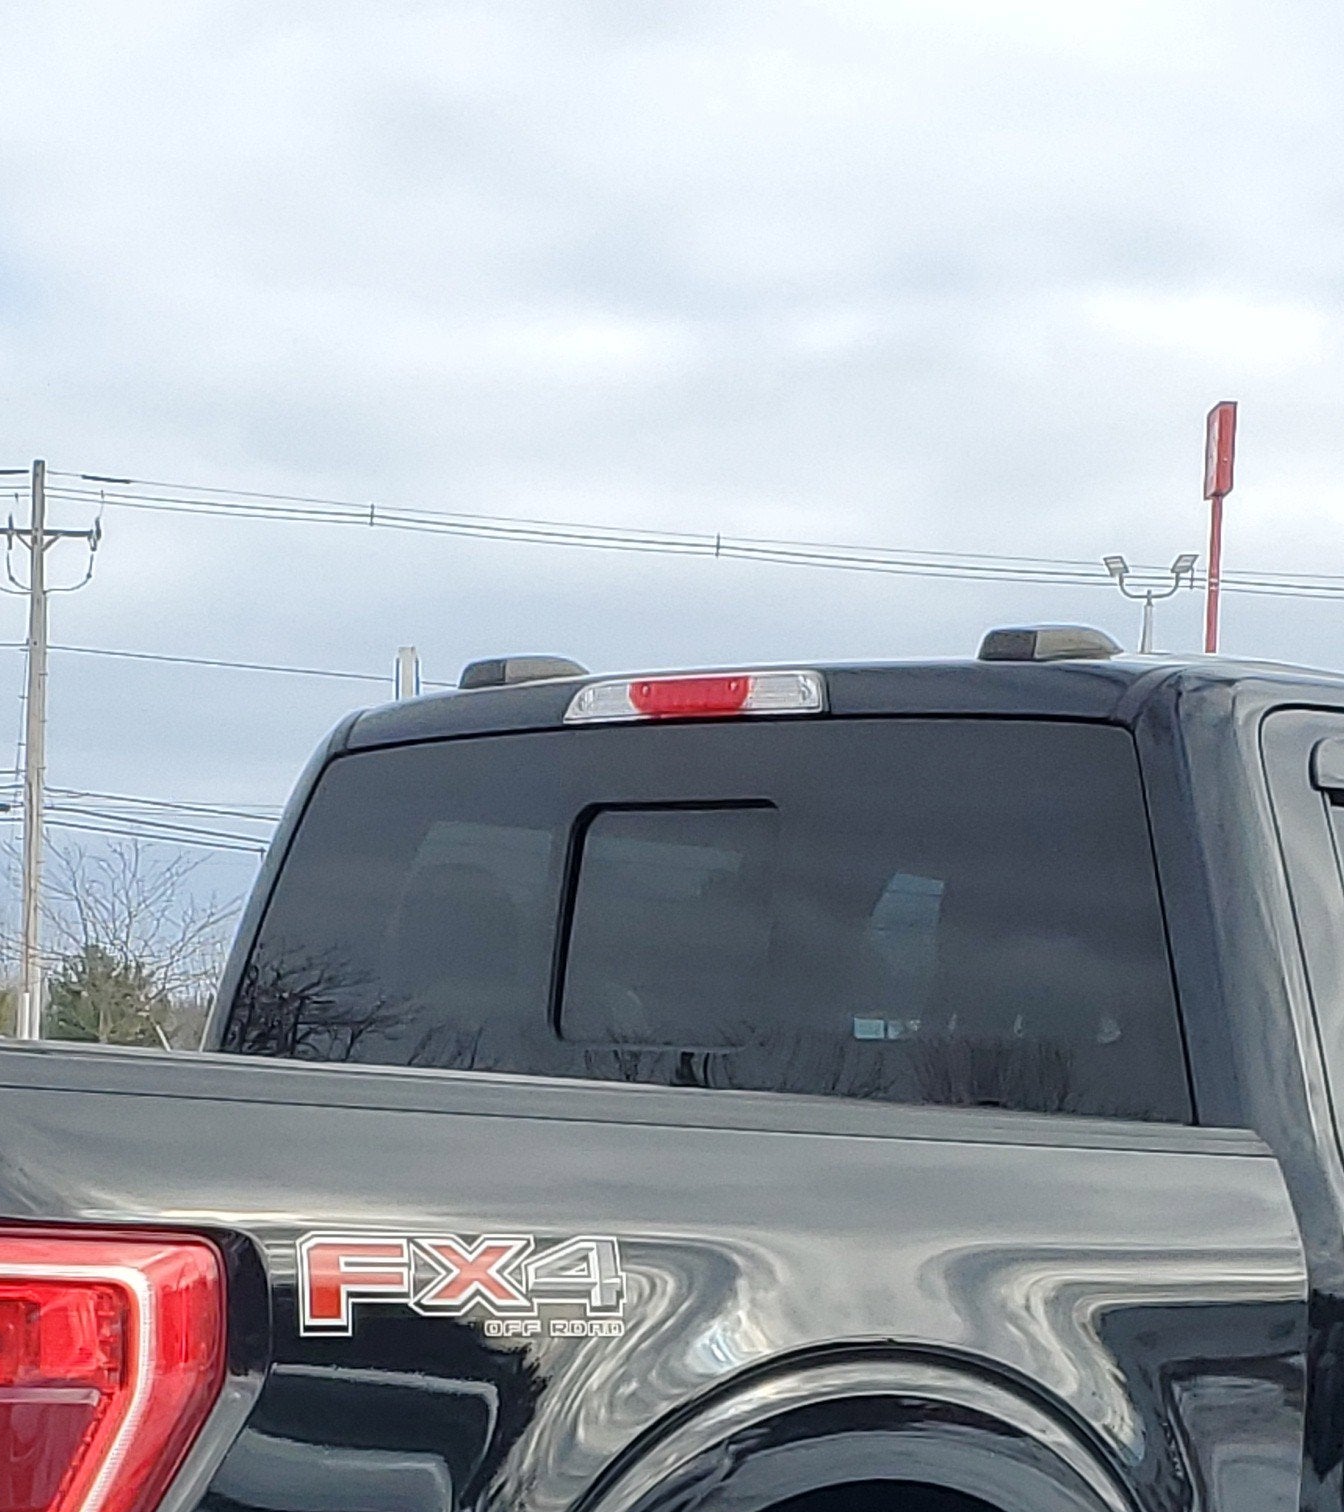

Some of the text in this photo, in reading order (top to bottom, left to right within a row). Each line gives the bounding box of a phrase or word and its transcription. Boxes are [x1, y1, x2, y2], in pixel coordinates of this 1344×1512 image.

[297, 1231, 626, 1337] FX4
[484, 1320, 625, 1337] OFF ROAD
